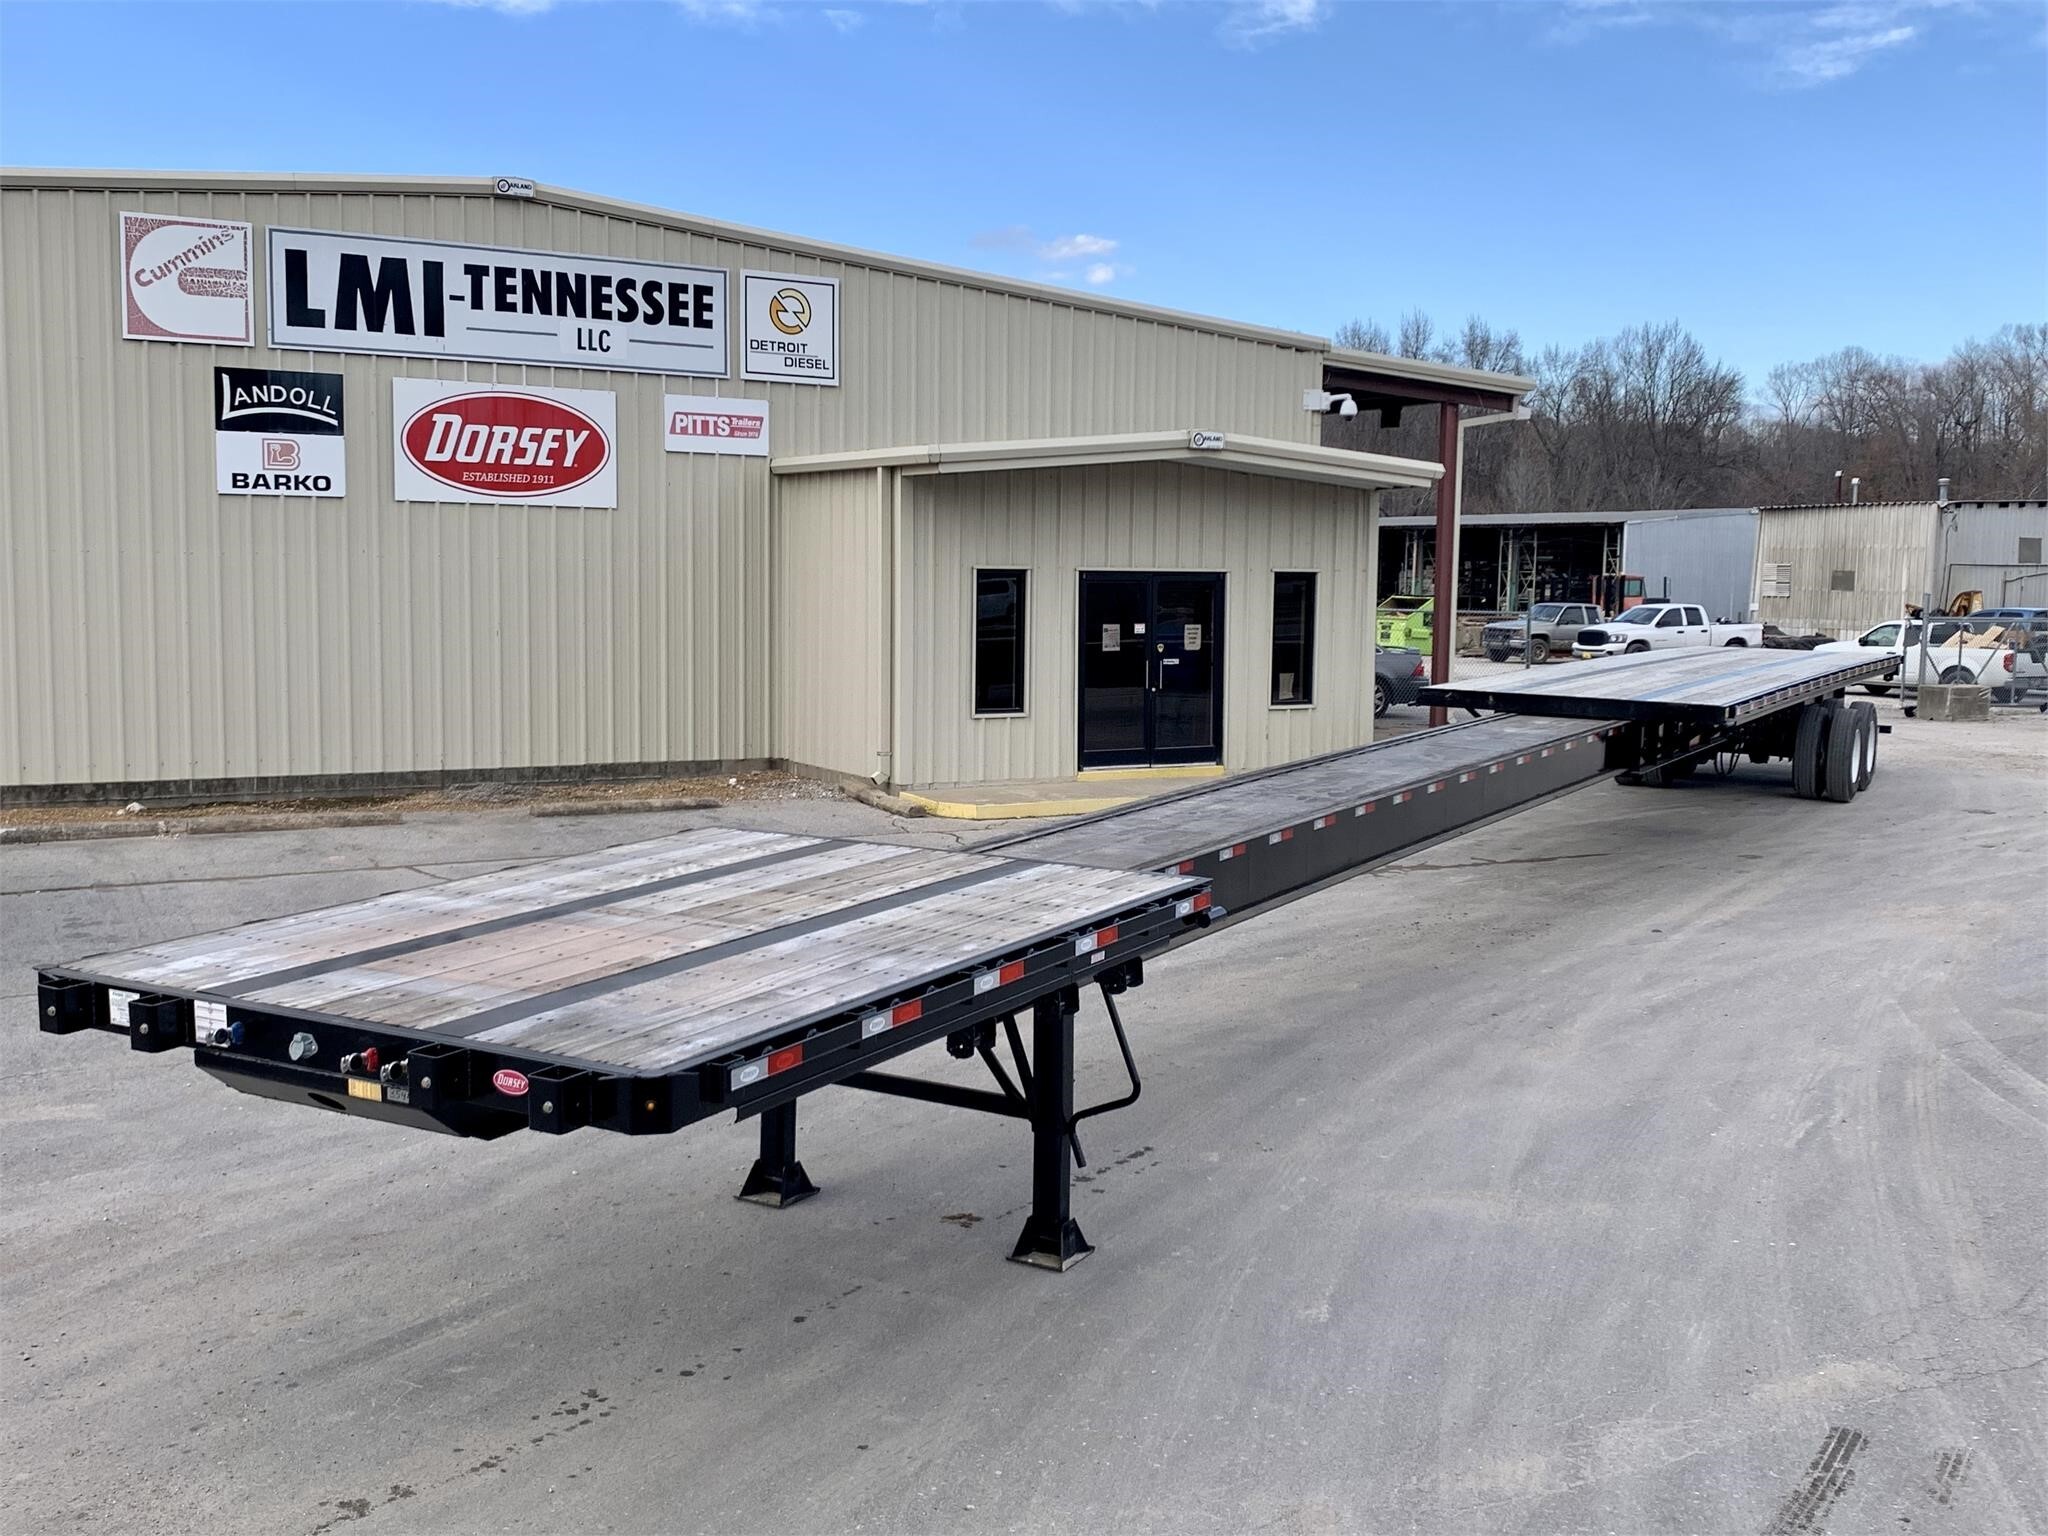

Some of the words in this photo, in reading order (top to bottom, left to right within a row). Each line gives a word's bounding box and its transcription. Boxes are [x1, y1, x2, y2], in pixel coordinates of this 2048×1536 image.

[134, 230, 235, 287] Cummins
[577, 327, 611, 353] LLC
[750, 339, 808, 354] DETROIT
[784, 356, 830, 370] DIESEL
[221, 372, 338, 422] LANDOLL
[675, 413, 730, 436] PITTS
[424, 413, 590, 468] DORSEY
[231, 472, 331, 491] BARKO
[462, 472, 530, 483] ESTABLISHED
[532, 475, 554, 484] 1911
[497, 1073, 526, 1089] DORSEY
